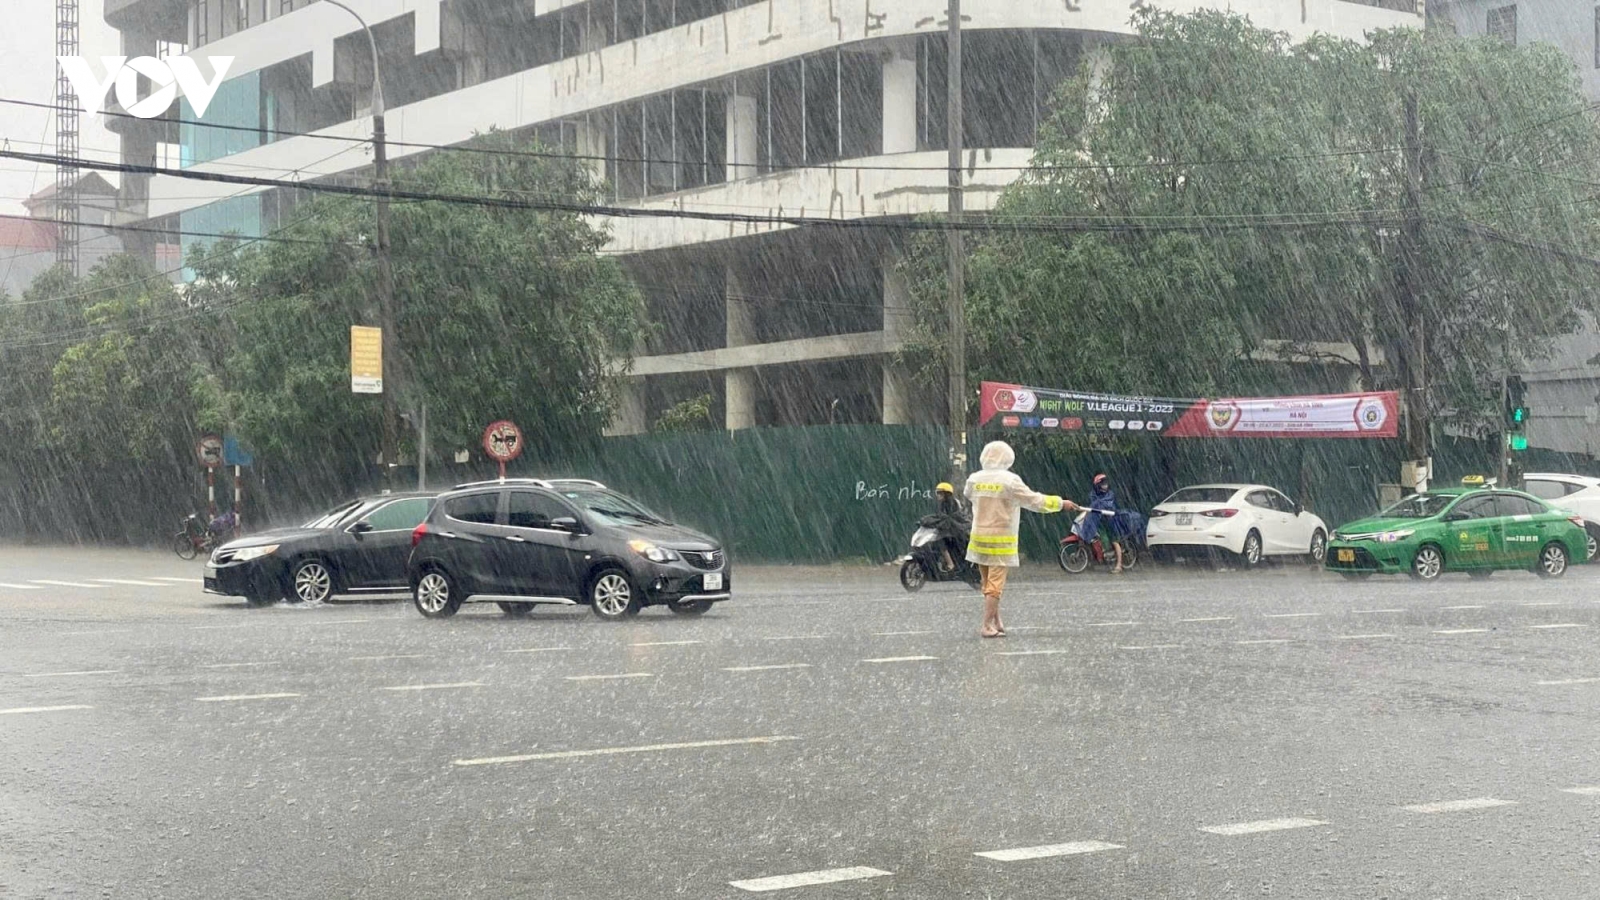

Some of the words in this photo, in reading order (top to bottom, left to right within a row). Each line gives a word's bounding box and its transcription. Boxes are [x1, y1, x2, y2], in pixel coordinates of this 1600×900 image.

[1040, 400, 1061, 411] NIGHT
[1065, 401, 1084, 411] WOLF
[1087, 402, 1135, 412] V.LEAGUE
[1149, 404, 1173, 413] 2023
